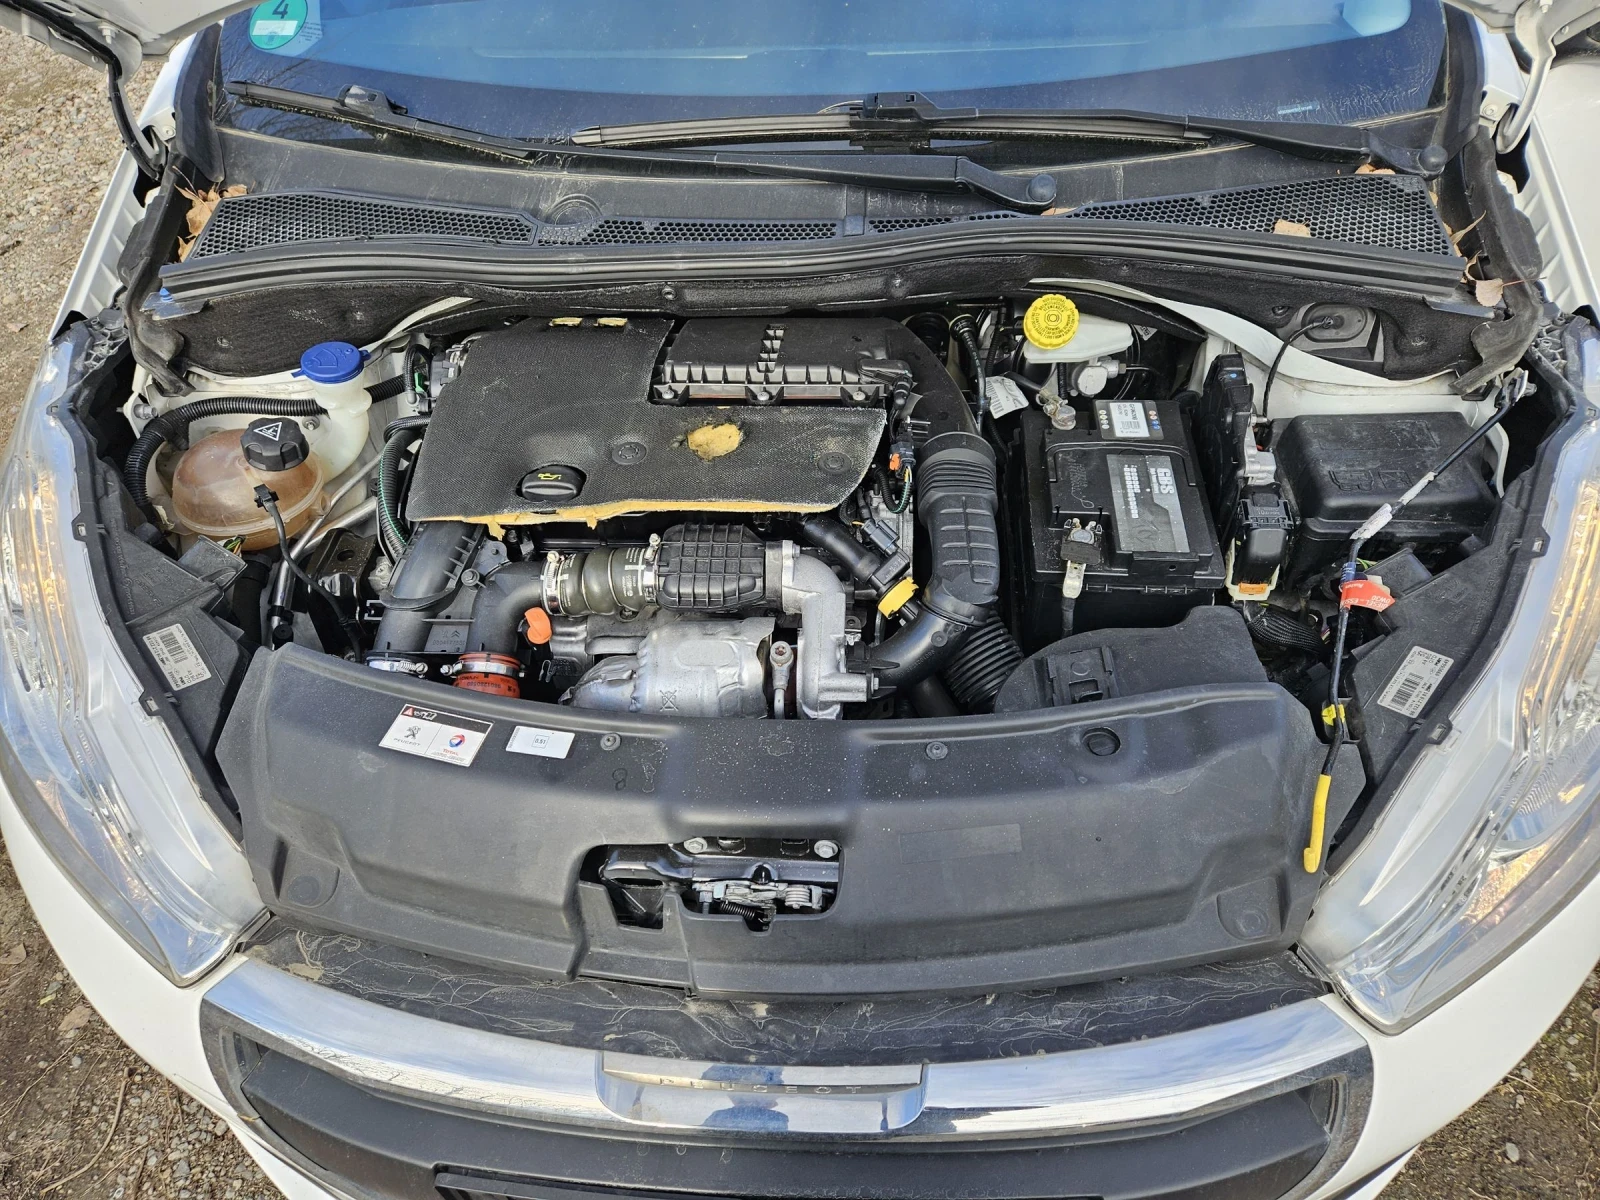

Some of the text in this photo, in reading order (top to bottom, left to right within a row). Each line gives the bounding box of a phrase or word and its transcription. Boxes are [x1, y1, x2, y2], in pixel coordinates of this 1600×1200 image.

[272, 0, 289, 19] 4
[1156, 467, 1175, 495] GBS
[393, 737, 421, 747] PEUGEOT
[442, 748, 459, 757] TOTAL
[660, 1078, 861, 1093] PEUGEOT
